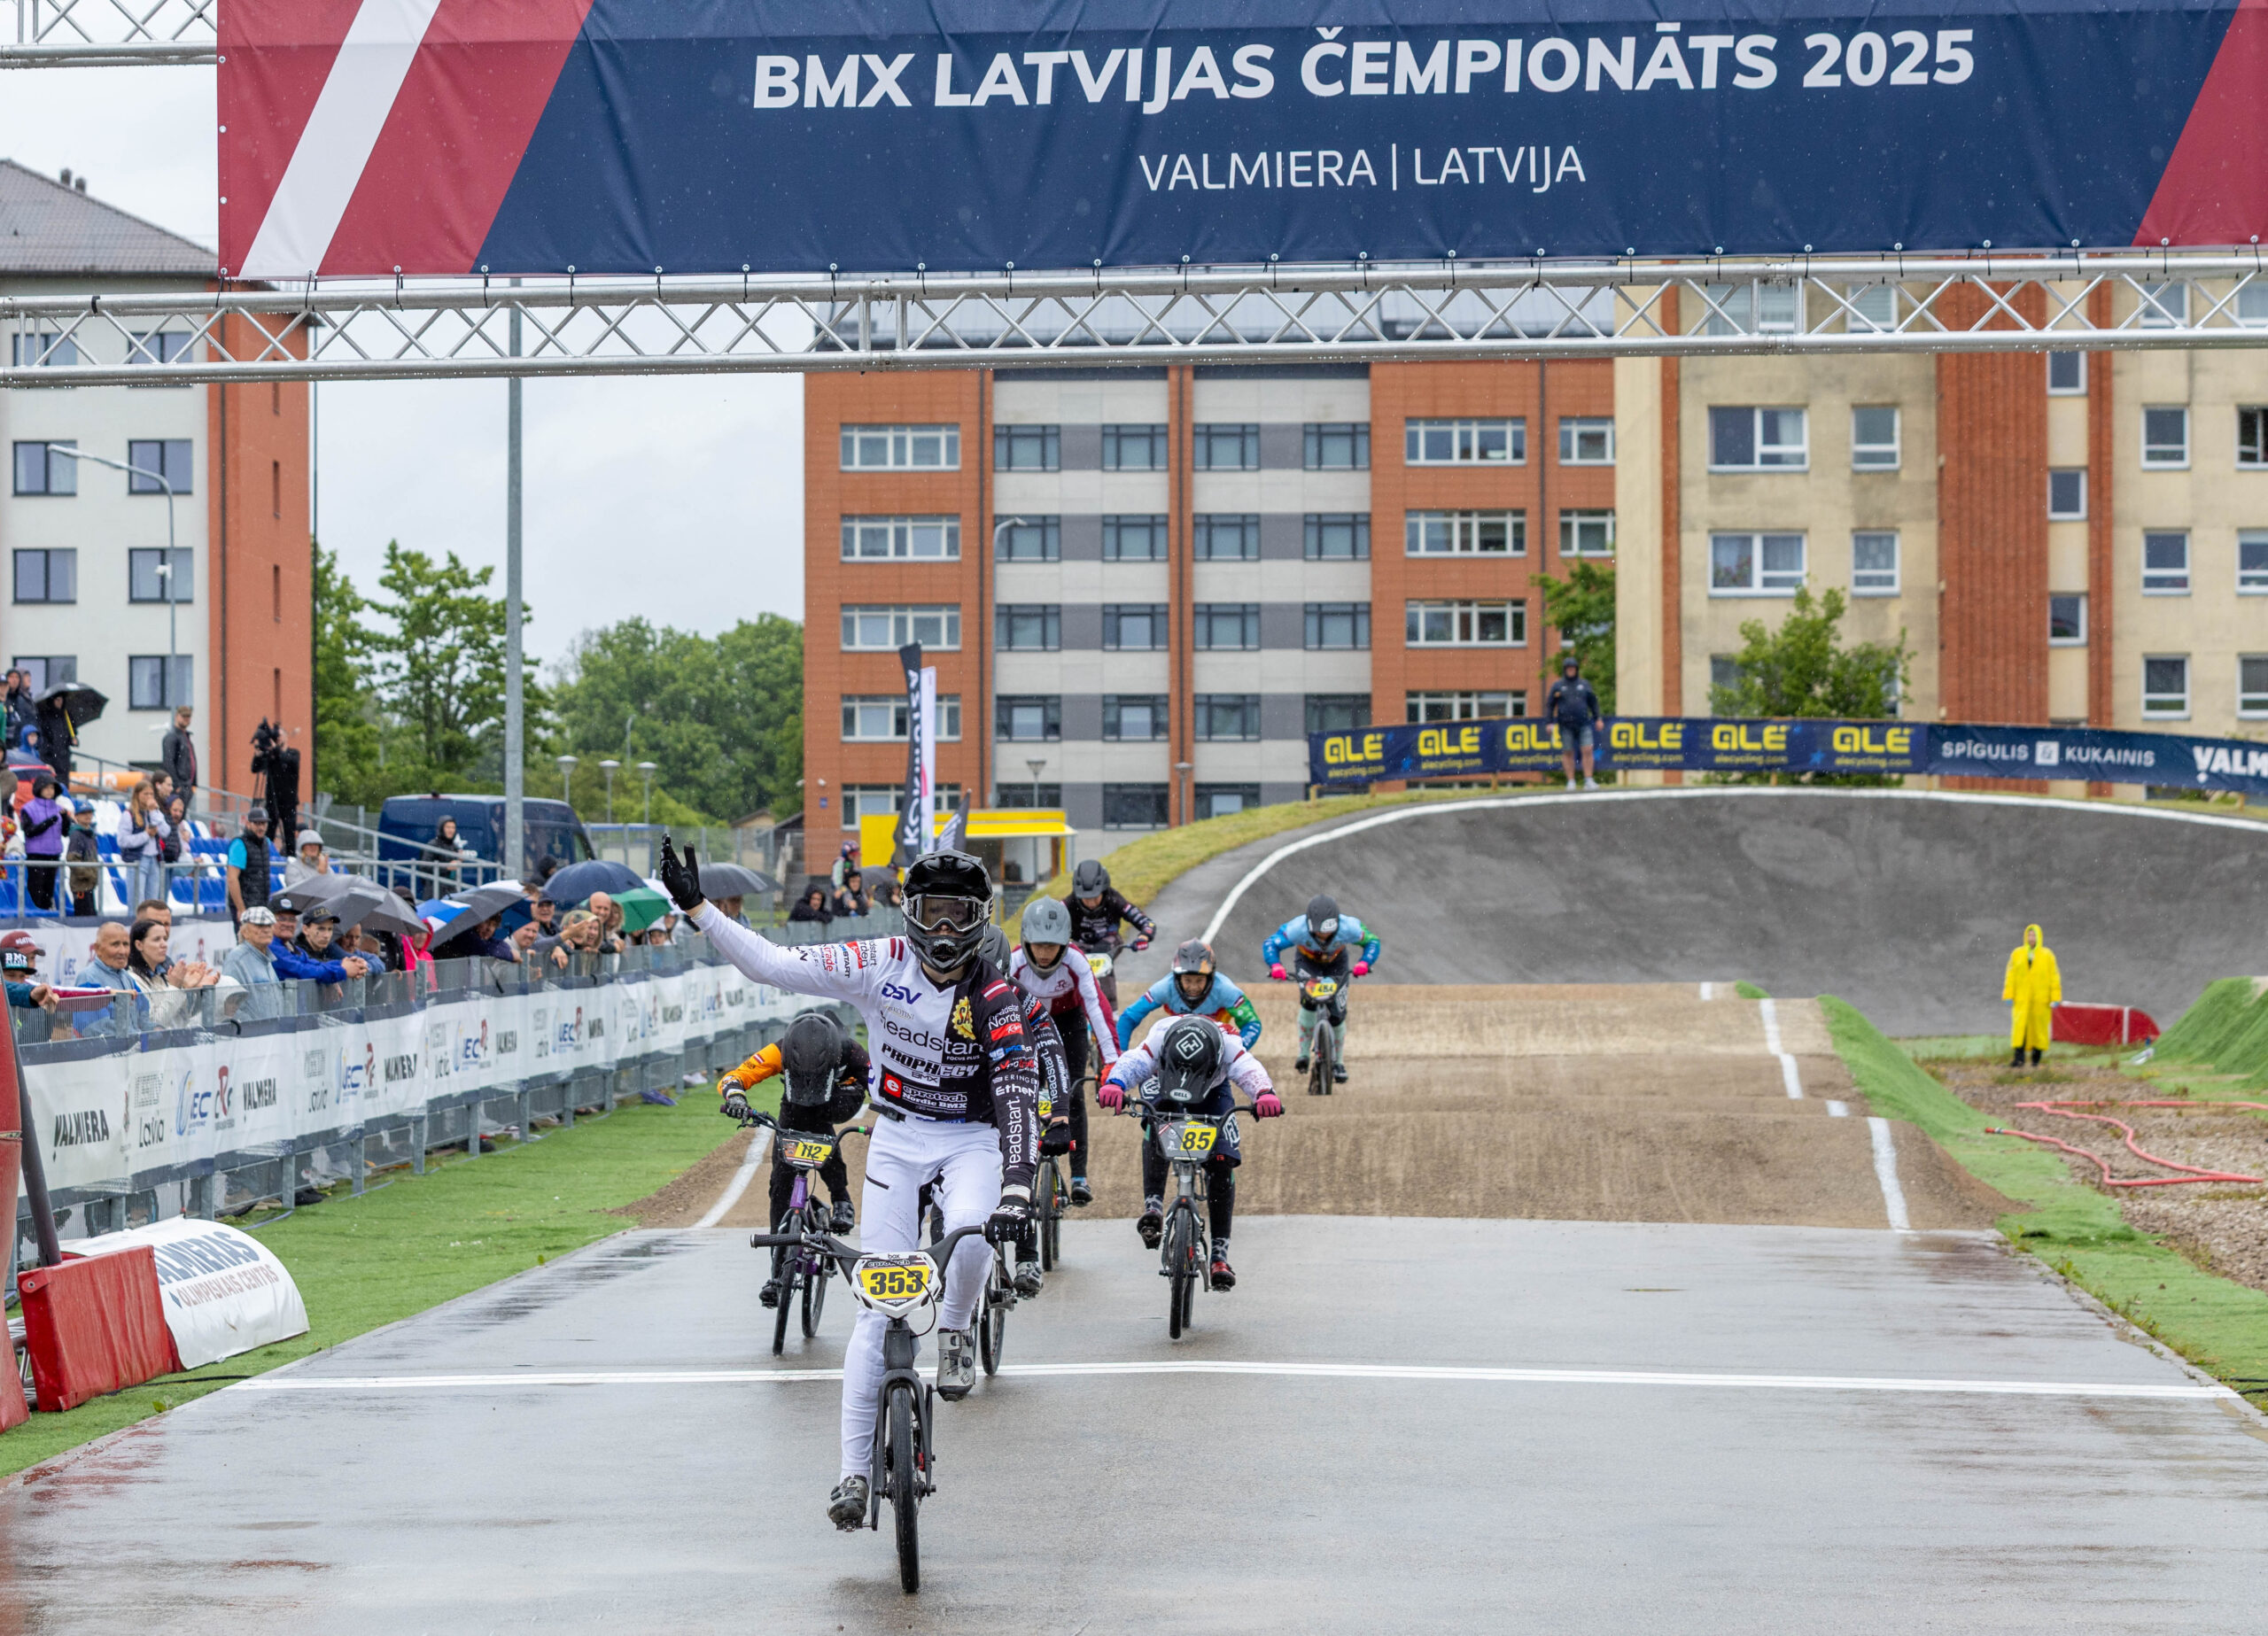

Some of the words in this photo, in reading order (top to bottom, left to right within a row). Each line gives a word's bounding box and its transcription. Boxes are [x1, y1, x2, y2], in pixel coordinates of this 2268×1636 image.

[753, 53, 916, 109] BMX
[934, 45, 1276, 115] LATVIJAS
[1301, 22, 1778, 97] ČEMPIONĀTS
[1802, 29, 1975, 88] 2025
[1138, 150, 1378, 191] VALMIERA
[1414, 145, 1587, 194] LATVIJA
[1942, 740, 2029, 762] SPĪGULIS
[2065, 747, 2155, 767] KUKAINIS
[882, 982, 922, 1004] DSV
[882, 1043, 980, 1077] PROPHECY
[912, 1071, 938, 1082] BMX
[902, 1092, 937, 1106] Nordic
[801, 1143, 823, 1159] 112
[1183, 1130, 1211, 1151] 85
[176, 1275, 245, 1307] OLIMPISKAIS
[237, 1264, 281, 1291] CENTRS
[869, 1269, 924, 1296] 353
